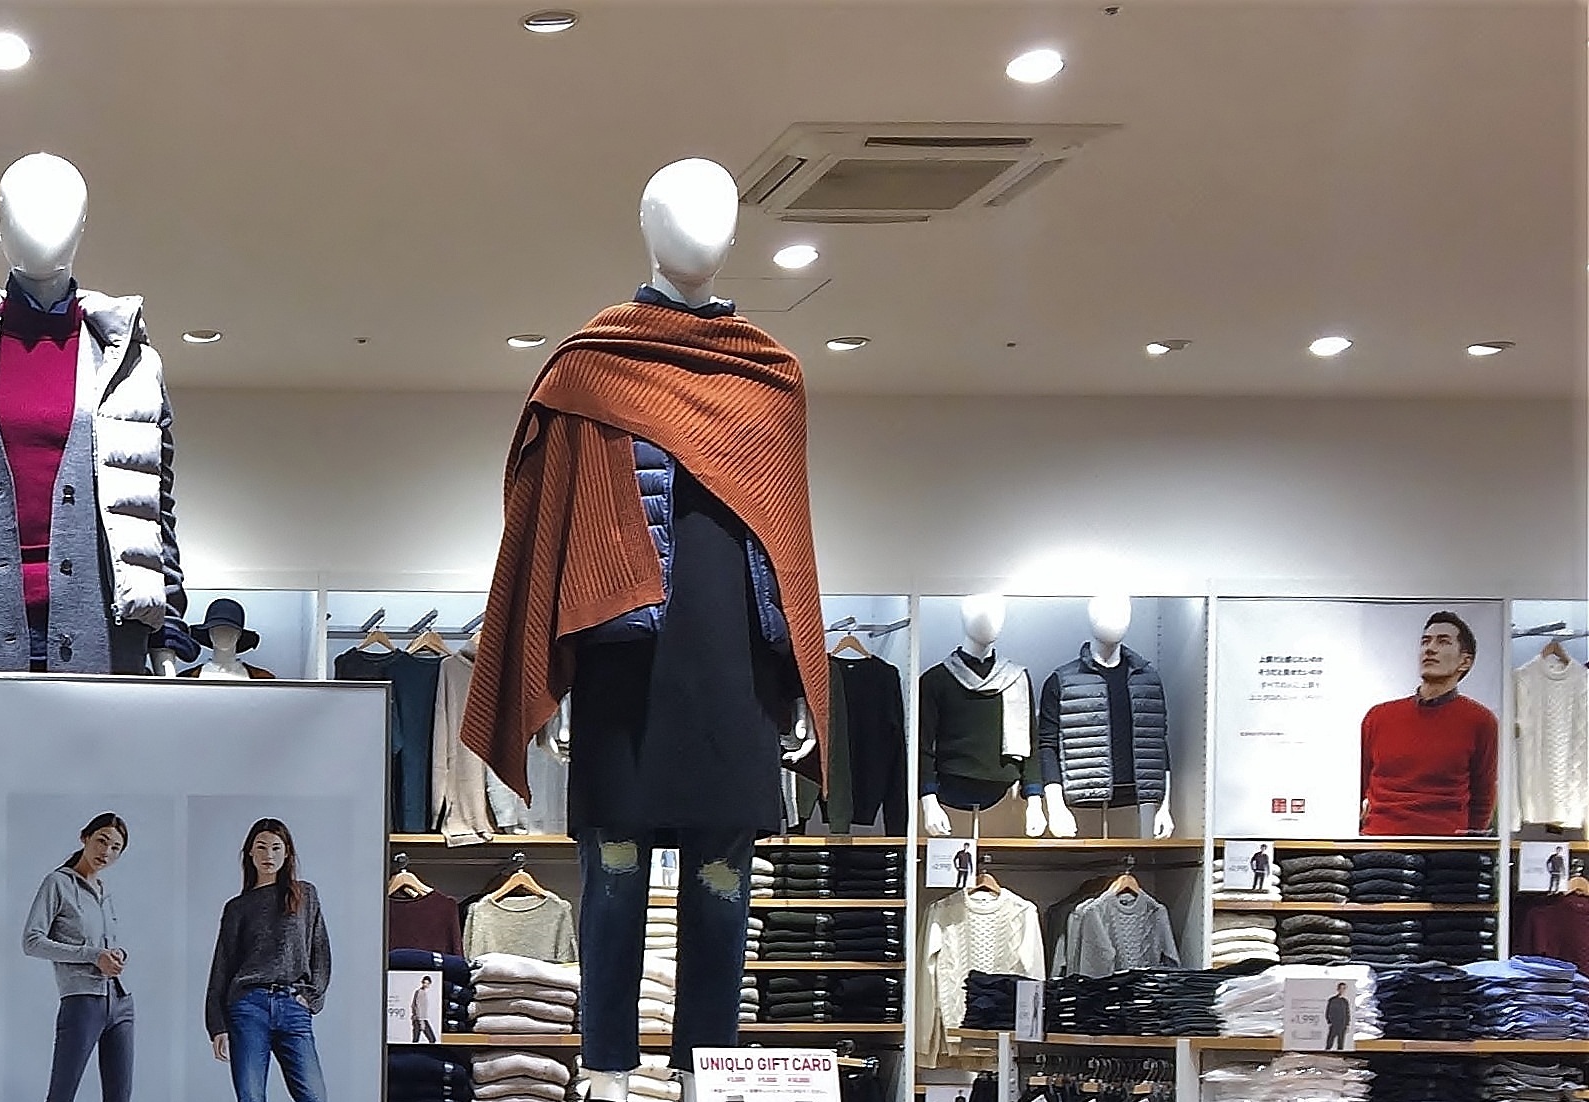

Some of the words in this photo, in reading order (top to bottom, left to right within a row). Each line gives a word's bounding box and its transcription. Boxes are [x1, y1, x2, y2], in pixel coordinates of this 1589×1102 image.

[388, 1008, 406, 1017] 990
[700, 1056, 754, 1072] UNIQLO
[757, 1057, 790, 1071] GIFT
[792, 1057, 832, 1072] CARD
